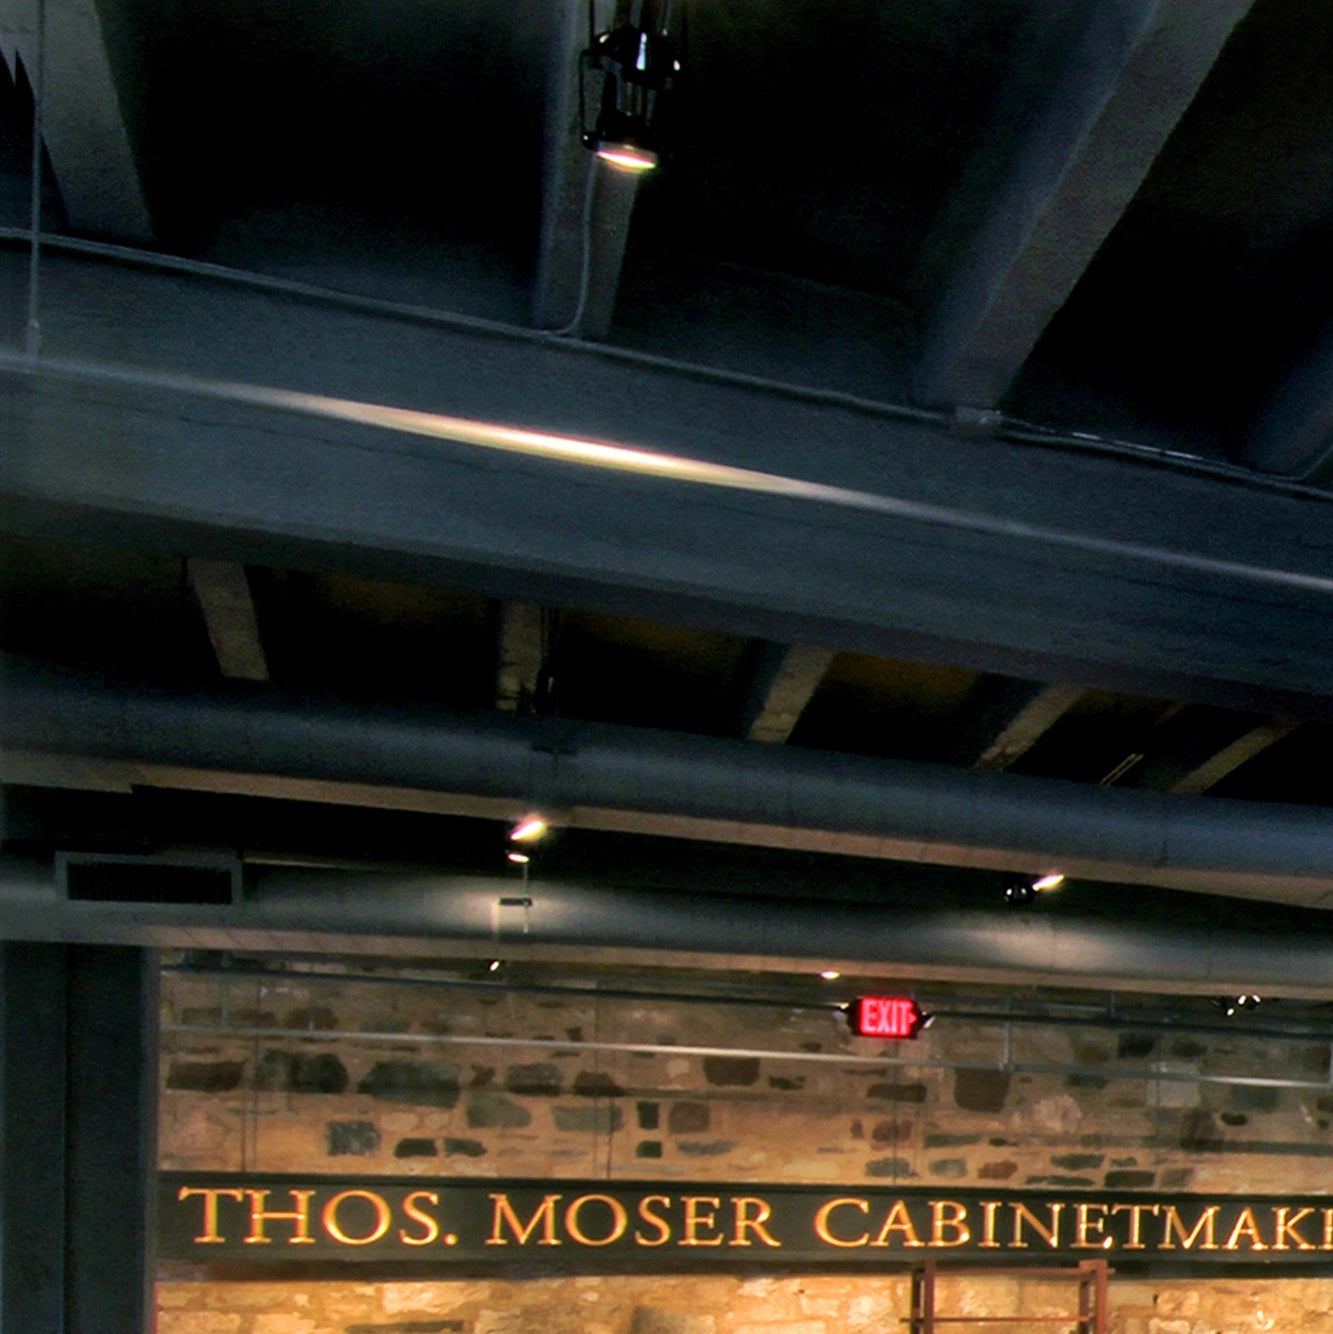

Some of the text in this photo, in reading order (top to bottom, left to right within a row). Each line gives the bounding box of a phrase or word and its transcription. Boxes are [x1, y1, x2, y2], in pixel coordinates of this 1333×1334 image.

[862, 1000, 914, 1035] EXIT
[178, 1186, 458, 1246] THOS.
[486, 1193, 782, 1248] MOSER
